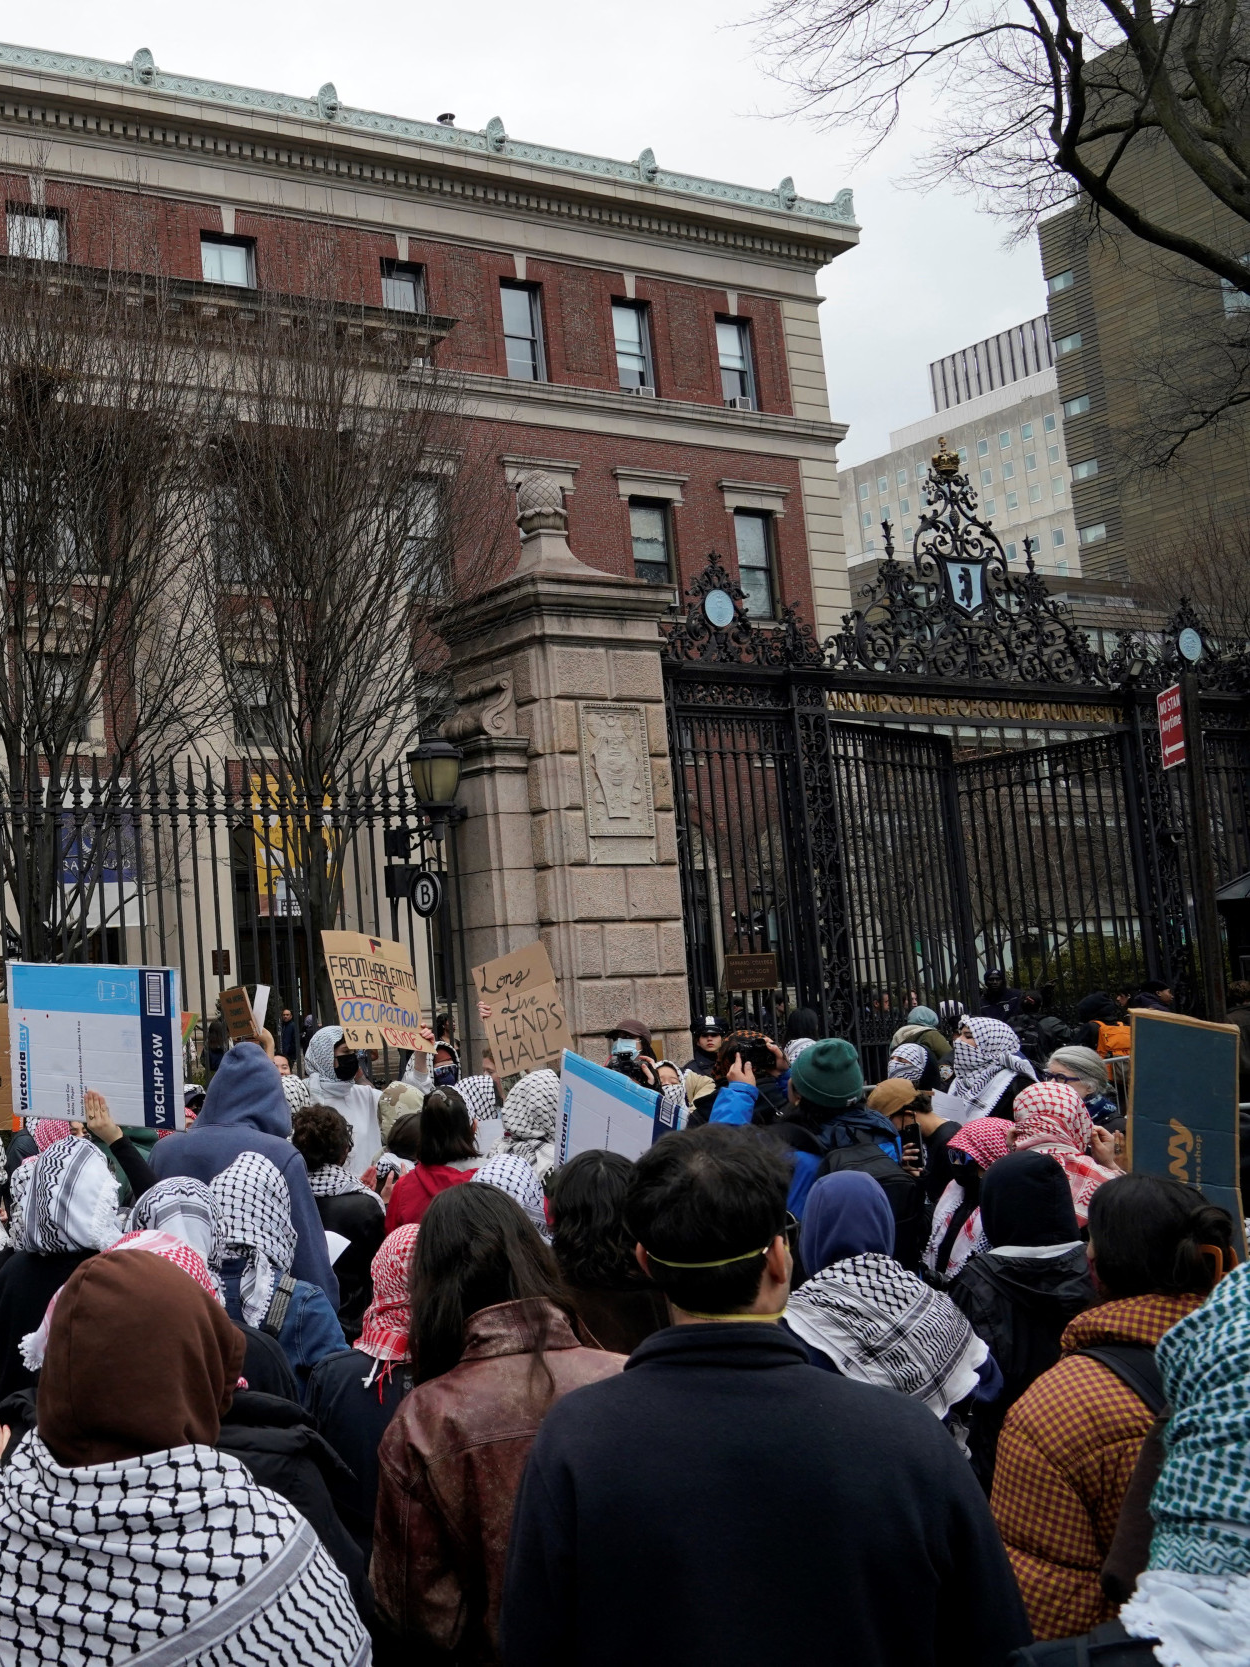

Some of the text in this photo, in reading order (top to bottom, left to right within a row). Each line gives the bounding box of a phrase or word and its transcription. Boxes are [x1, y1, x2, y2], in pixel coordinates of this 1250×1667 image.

[826, 691, 888, 713] ARNARD
[889, 695, 957, 717] COLLEGE
[978, 699, 1050, 721] COLUMBIA
[1049, 703, 1124, 724] UNIVERSITY
[1159, 693, 1181, 716] NO STAN
[1161, 713, 1182, 733] Anytime
[420, 884, 431, 906] B
[328, 955, 369, 978] FROM
[368, 960, 406, 988] HARLEM
[480, 966, 530, 994] Long
[334, 978, 398, 1006] PALESTINE
[501, 992, 540, 1014] Live
[493, 1002, 562, 1045] HIND'S
[365, 1029, 374, 1044] A
[383, 1027, 423, 1050] CRIME
[499, 1033, 561, 1071] HALL
[151, 1033, 166, 1125] VBCLHP16W
[1194, 1134, 1203, 1163] shop
